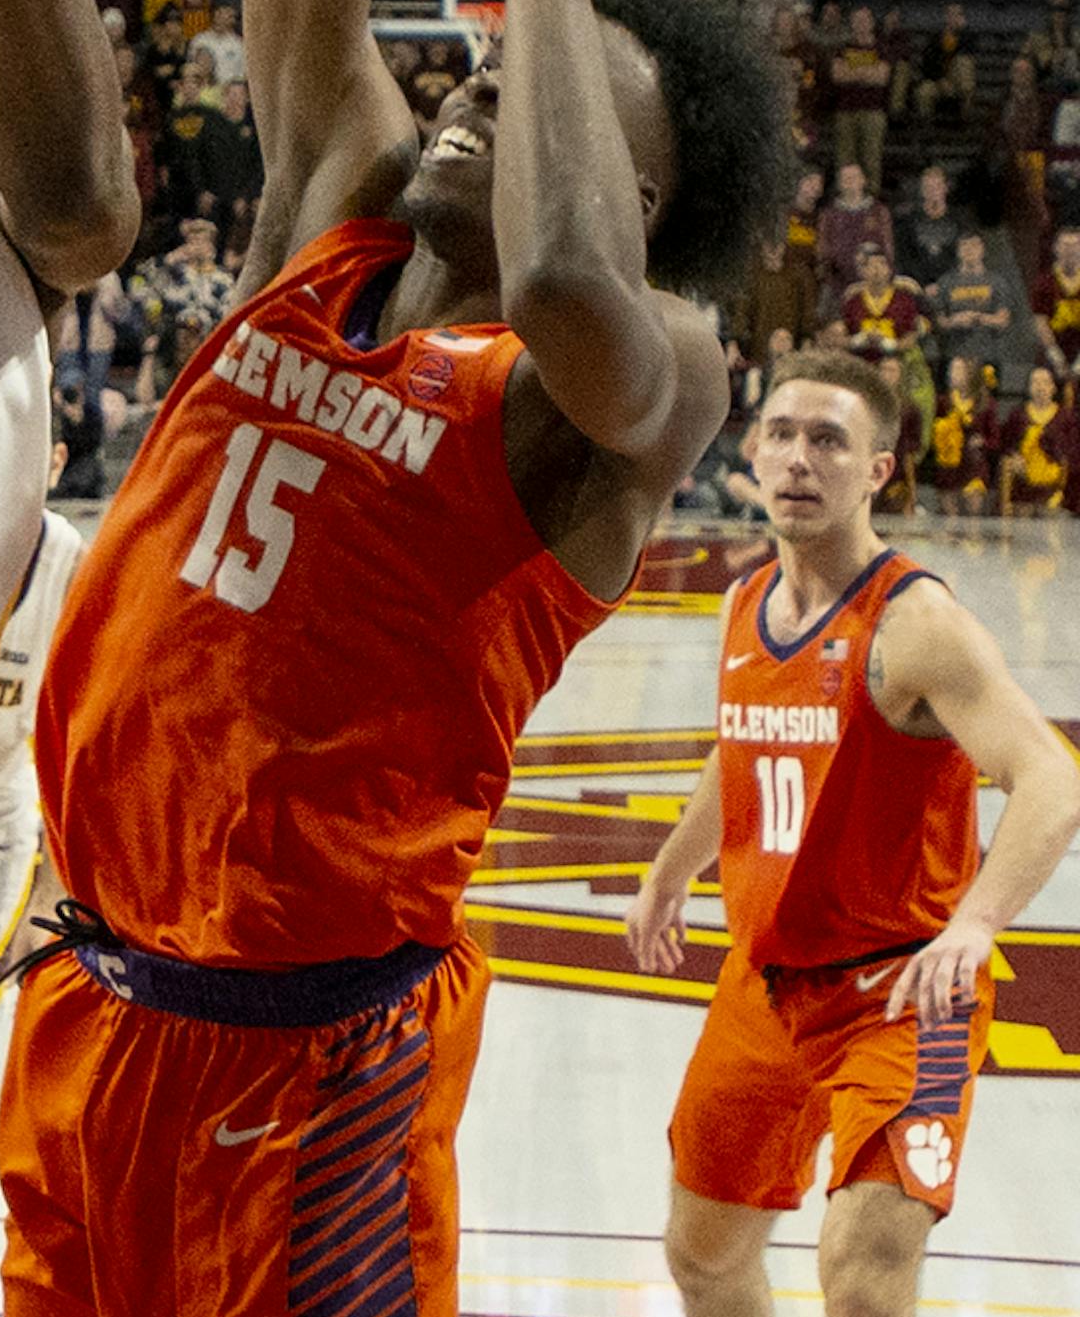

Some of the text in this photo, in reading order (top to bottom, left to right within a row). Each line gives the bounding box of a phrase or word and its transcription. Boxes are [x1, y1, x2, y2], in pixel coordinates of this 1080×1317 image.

[213, 320, 448, 475] LEMSON
[179, 422, 327, 613] 15
[721, 703, 839, 744] CLEMSON
[756, 756, 804, 854] 10
